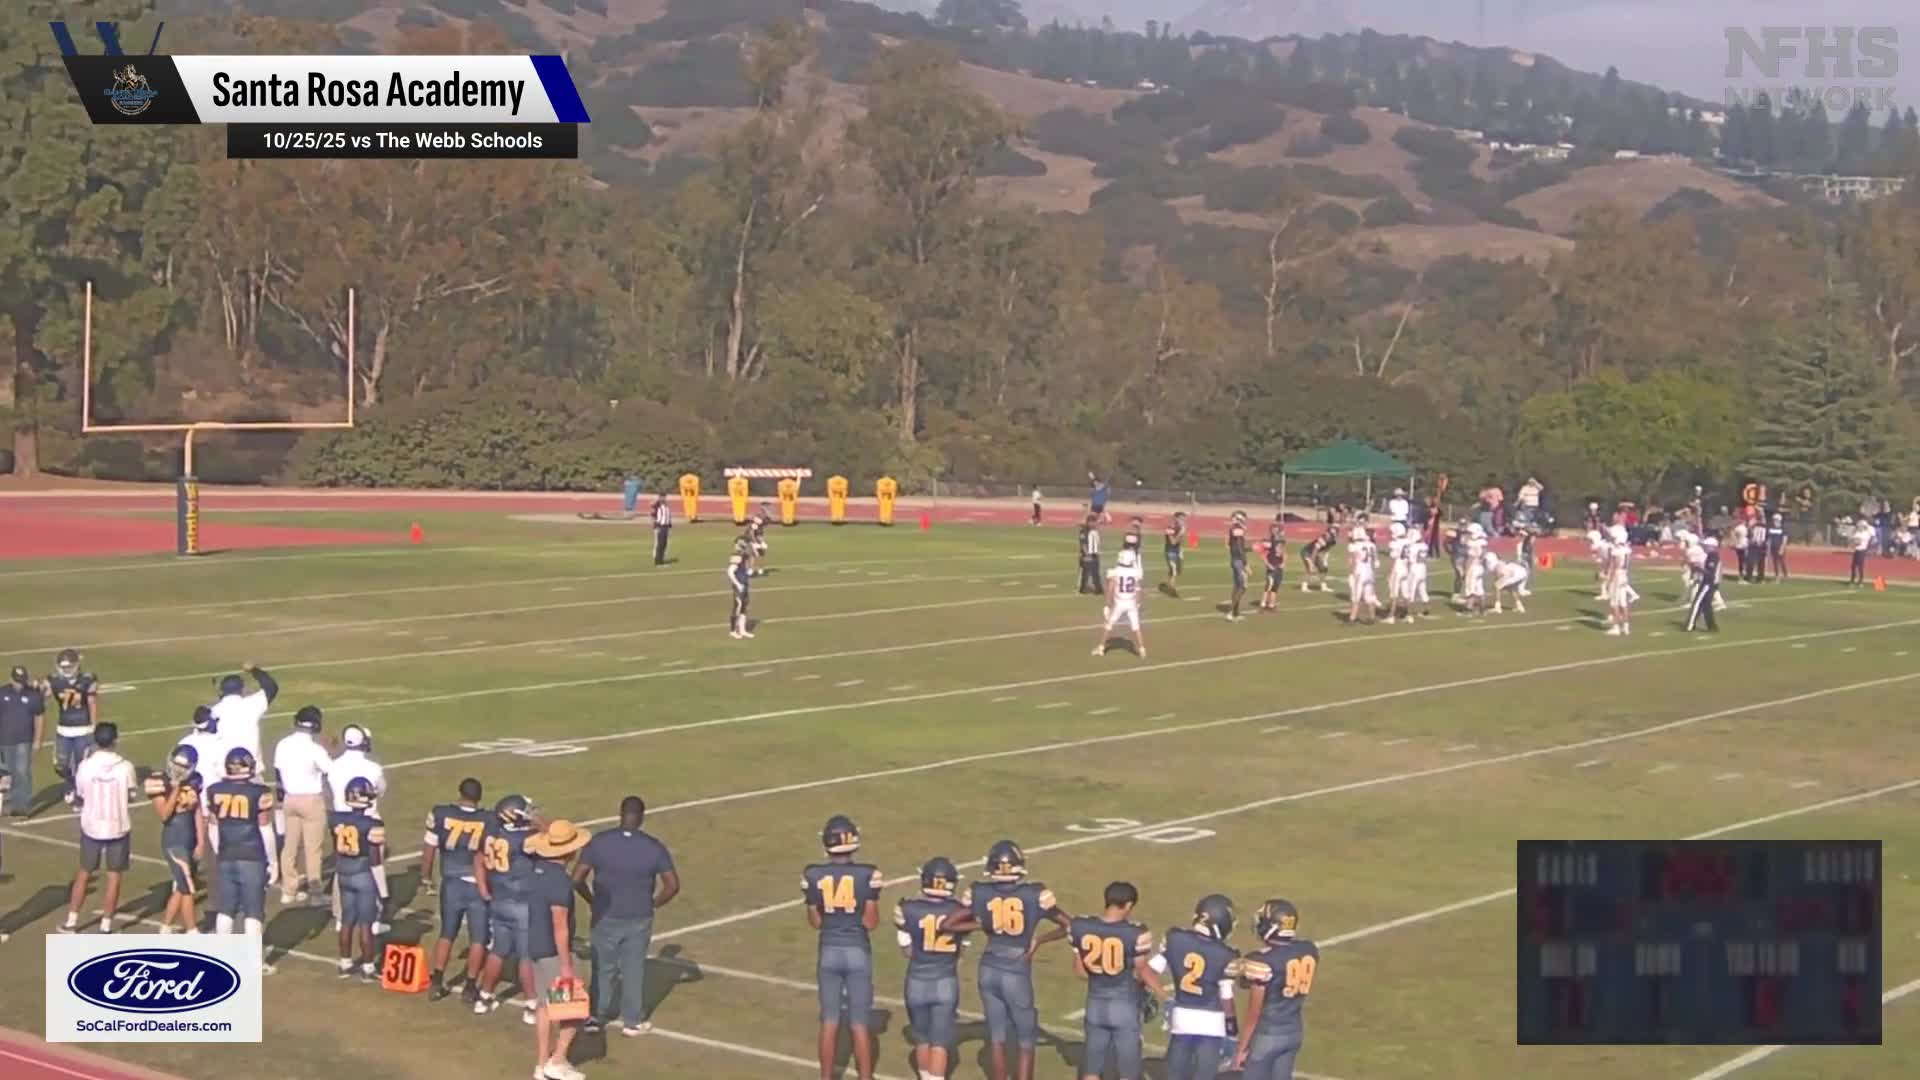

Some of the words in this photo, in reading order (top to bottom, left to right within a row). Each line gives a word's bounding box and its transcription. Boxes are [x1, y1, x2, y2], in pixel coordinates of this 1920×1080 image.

[1118, 576, 1136, 593] 12
[213, 793, 250, 819] 70
[443, 816, 485, 851] 77
[484, 835, 511, 873] 53
[817, 874, 857, 914] 14
[919, 914, 957, 953] 12
[986, 896, 1025, 936] 16
[386, 949, 416, 985] 30
[1081, 933, 1124, 976] 20
[1180, 952, 1206, 996] 2
[1282, 954, 1316, 998] 99
